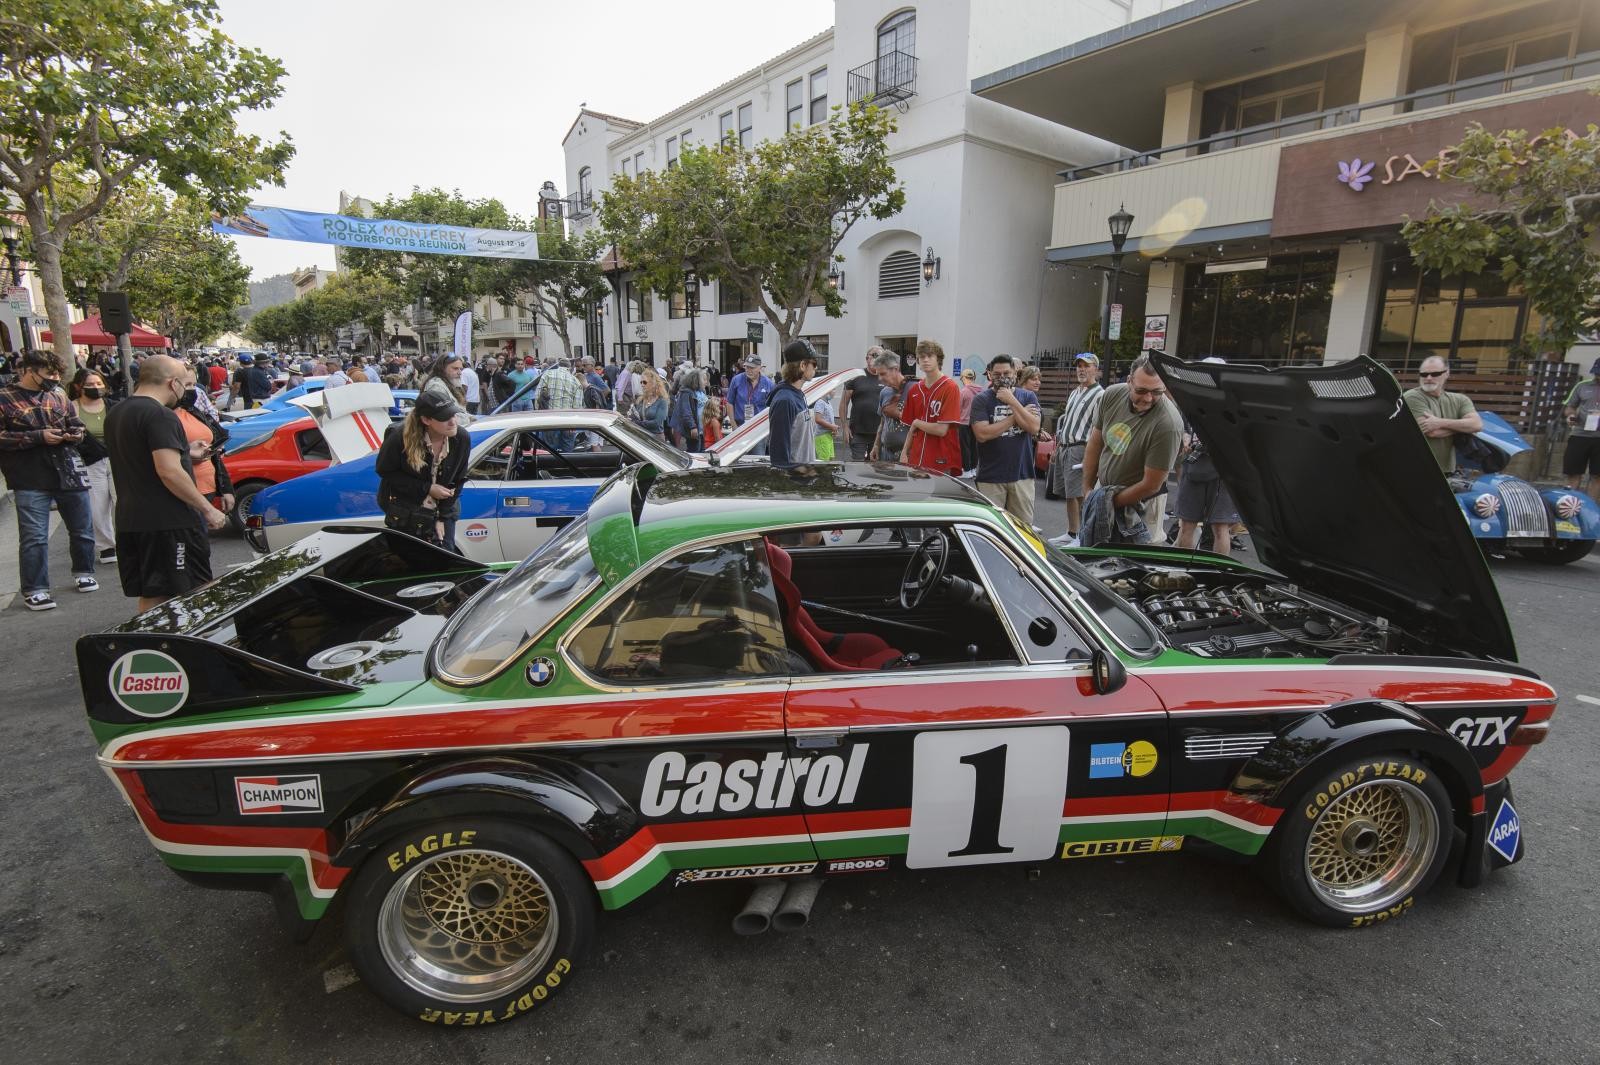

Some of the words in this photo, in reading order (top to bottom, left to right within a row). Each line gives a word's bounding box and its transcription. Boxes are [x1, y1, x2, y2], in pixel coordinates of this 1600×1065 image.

[323, 218, 378, 235] ROLEX
[383, 224, 466, 241] MONTEREY
[327, 231, 415, 247] MOTORSPORTS
[419, 239, 466, 251] REUNION
[477, 238, 505, 246] August
[123, 675, 182, 692] Castrol
[1449, 716, 1518, 747] GTX
[640, 743, 870, 817] Castrol
[243, 788, 316, 802] CHAMPION
[947, 743, 1014, 857] 1
[1493, 816, 1519, 844] ARAL
[387, 830, 477, 872] EAGLE
[702, 863, 814, 878] DUNLOP
[829, 859, 885, 871] FERODO
